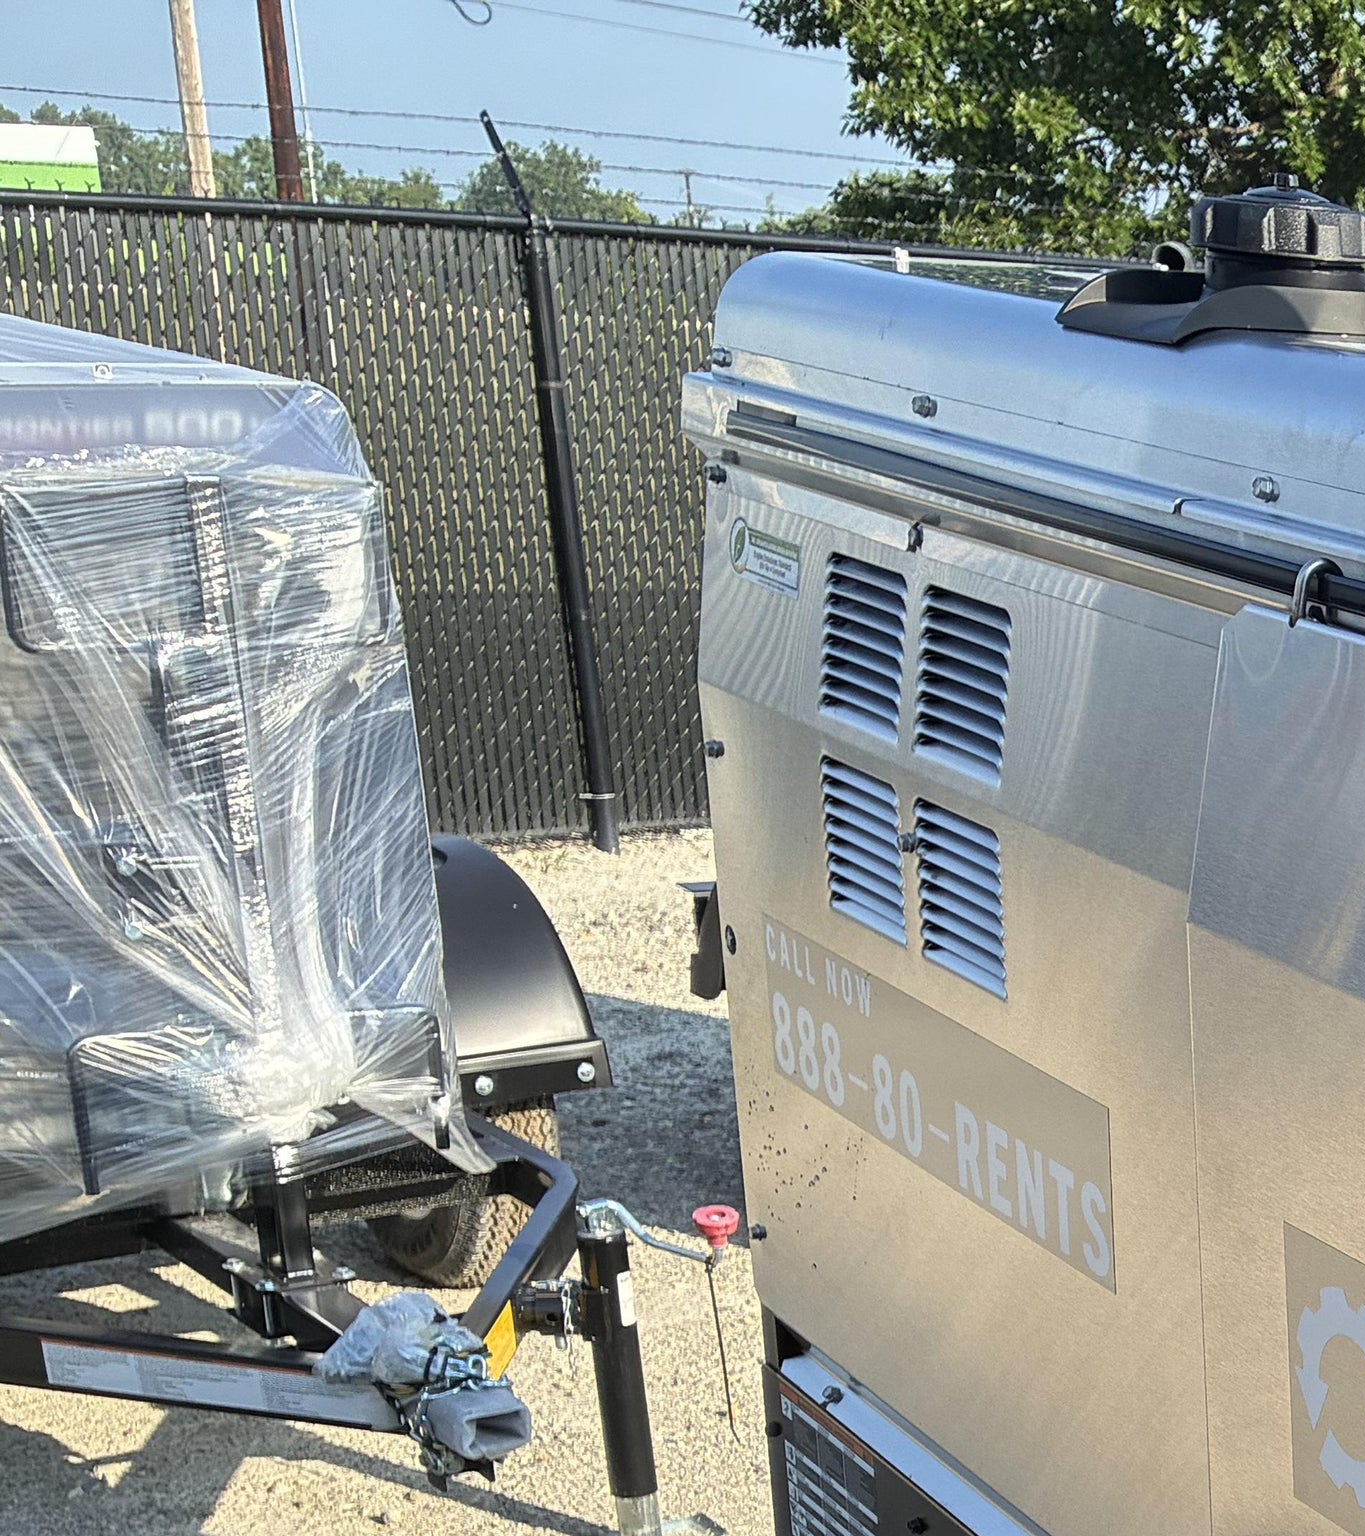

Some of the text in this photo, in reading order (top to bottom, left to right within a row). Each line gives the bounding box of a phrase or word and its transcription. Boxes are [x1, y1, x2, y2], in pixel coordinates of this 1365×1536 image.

[765, 924, 871, 1017] CALL NOW
[772, 991, 1110, 1277] 888-80-RENTS
